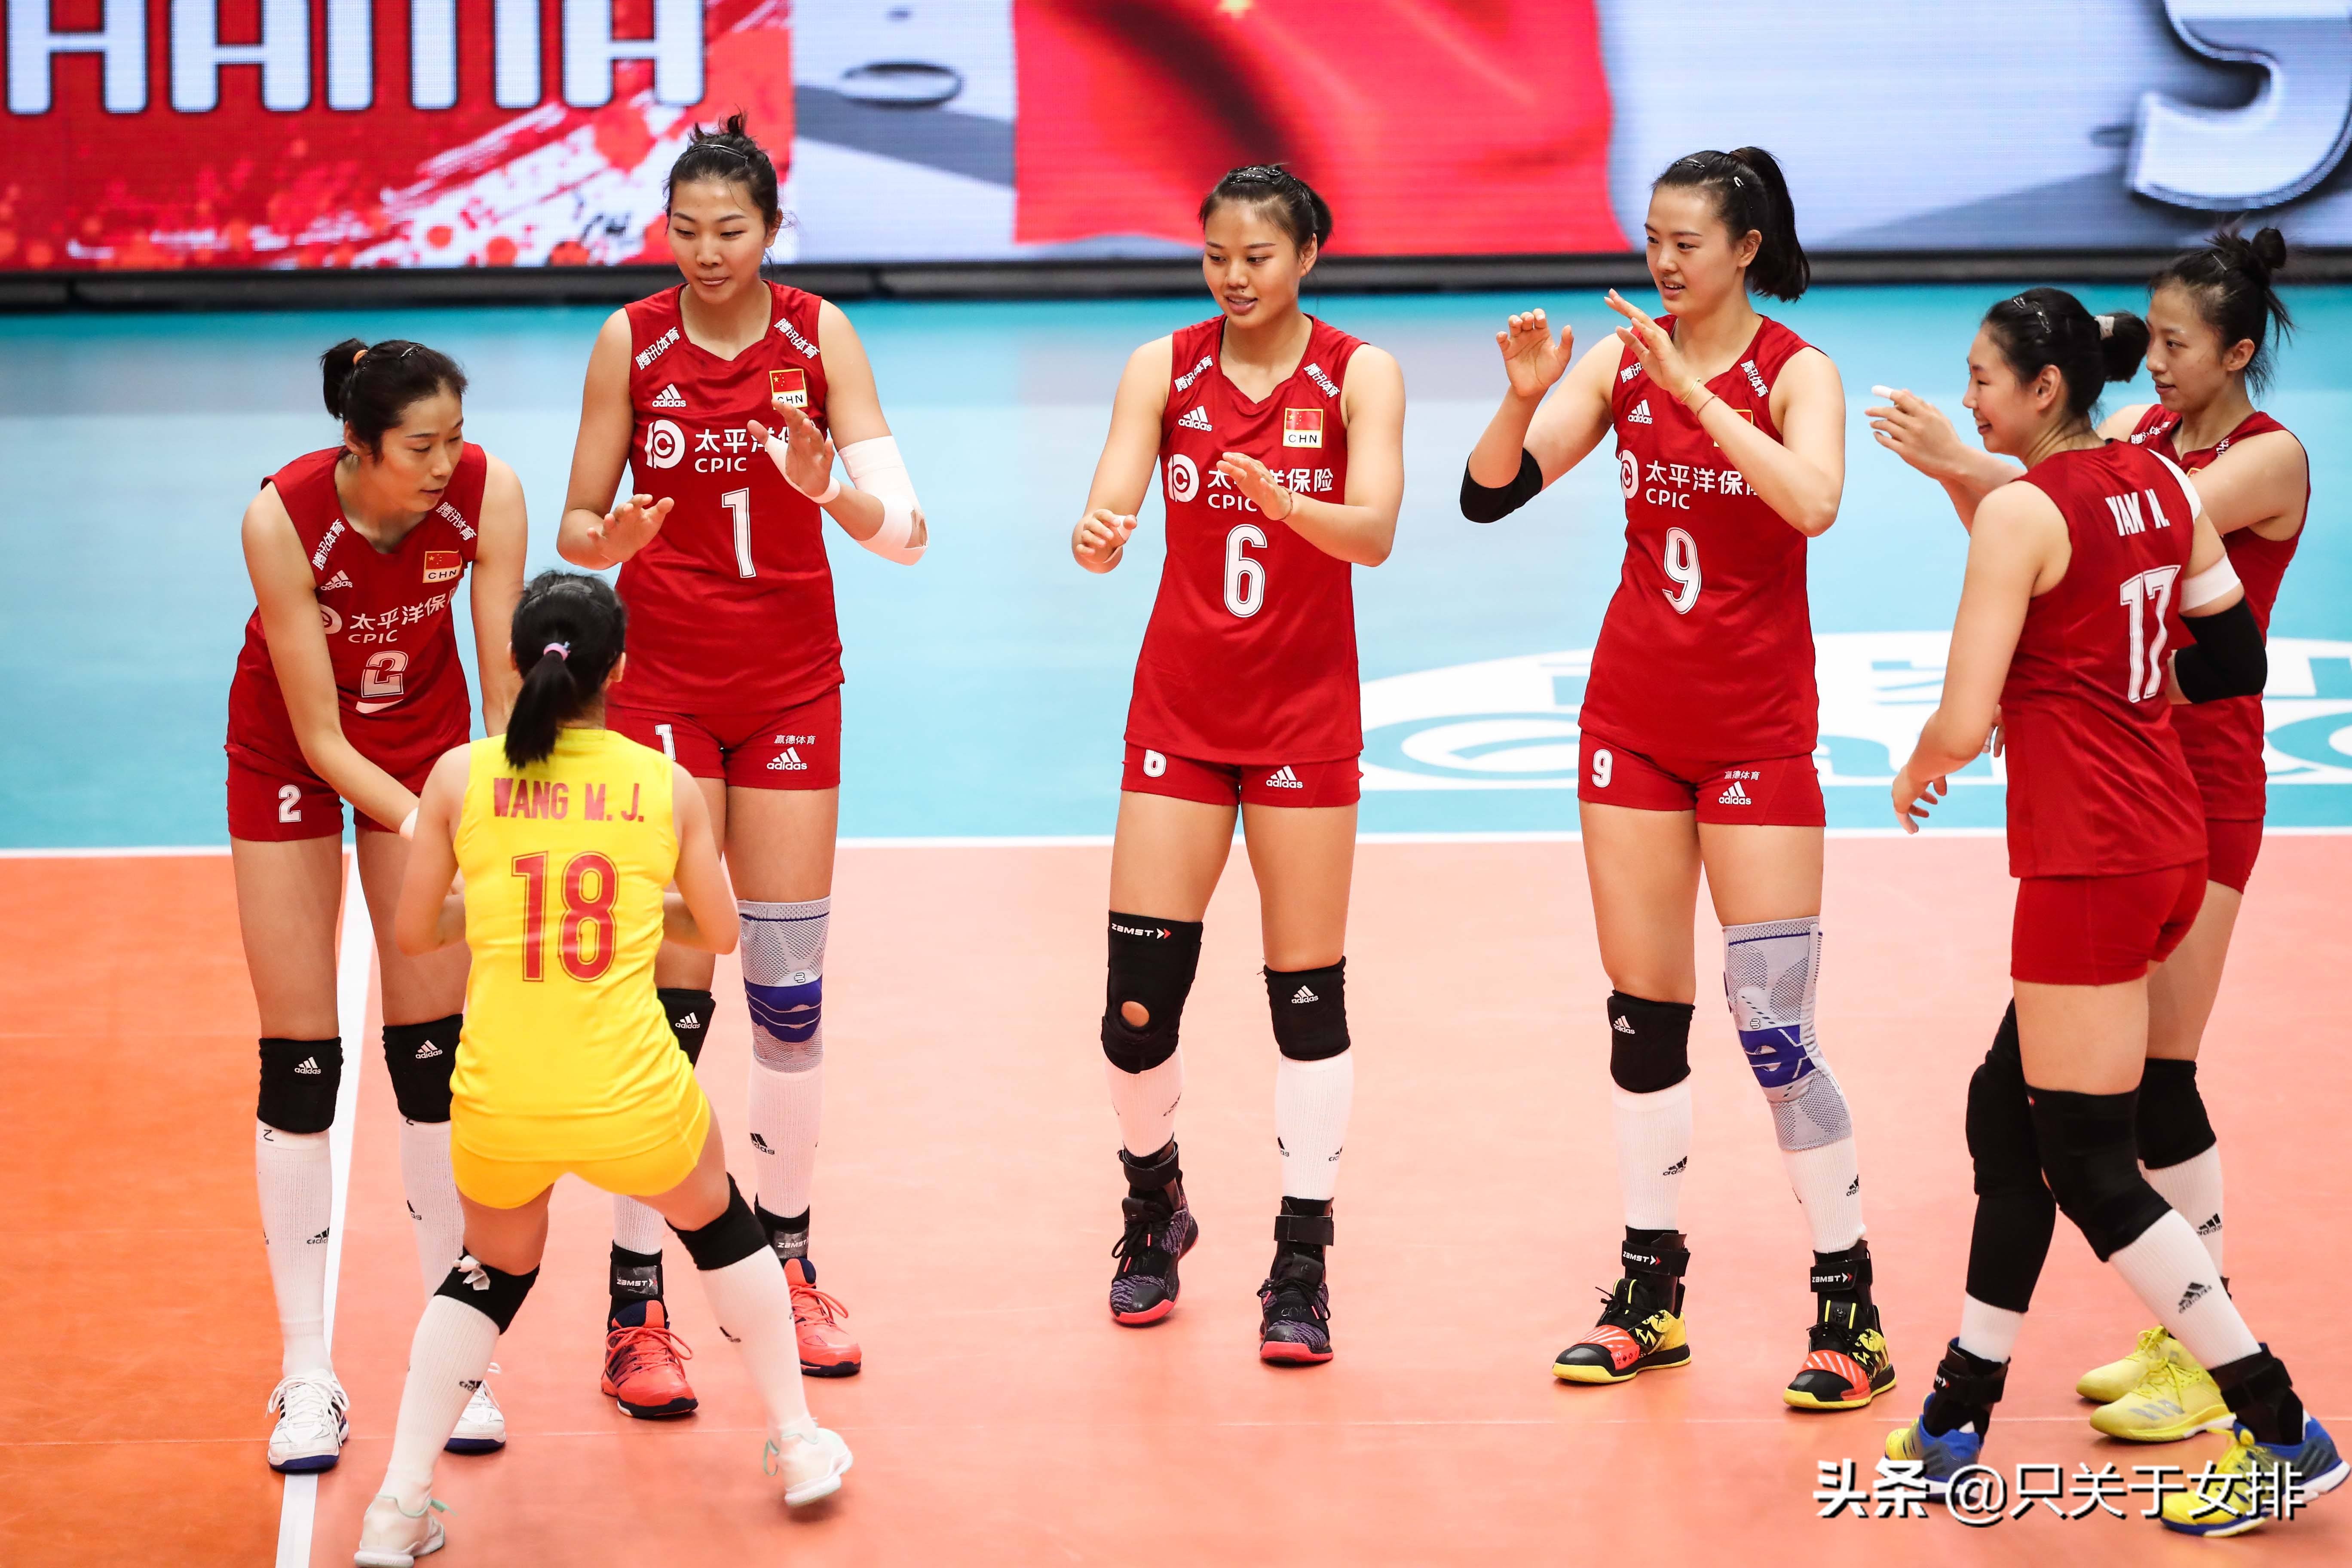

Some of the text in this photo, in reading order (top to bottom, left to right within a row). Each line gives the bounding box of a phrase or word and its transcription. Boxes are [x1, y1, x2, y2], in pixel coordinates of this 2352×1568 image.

[635, 327, 681, 370] 腾讯体育
[774, 318, 820, 359] 腾讯体育
[1174, 355, 1213, 392] 腾讯体育
[1303, 363, 1340, 398] 腾讯体育
[1620, 362, 1644, 383] 腾讯
[1740, 360, 1768, 398] 腾讯体育
[652, 398, 686, 407] adidas
[1178, 418, 1212, 432] adidas
[1628, 413, 1653, 425] adidas
[1289, 434, 1317, 444] CHN
[695, 457, 747, 472] CPIC
[1208, 494, 1257, 511] CPIC
[1646, 488, 1690, 510] CPIC
[436, 502, 477, 541] 腾讯体育
[2105, 492, 2146, 536] YAN
[312, 518, 345, 570] 腾讯体育
[722, 487, 756, 578] 1
[428, 569, 456, 580] CHN
[1224, 524, 1267, 618] 6
[1662, 527, 1702, 615] 9
[320, 580, 352, 591] adidas
[349, 585, 456, 631] 太平洋保
[348, 630, 397, 643] CPIC
[2120, 564, 2181, 703] 17
[361, 650, 408, 698] 2
[655, 724, 676, 761] 1
[774, 735, 816, 745] 赢德体育
[766, 761, 808, 770] adidas
[1592, 749, 1613, 788] 9
[1724, 770, 1761, 781] 赢德体育
[1266, 778, 1303, 788] adidas
[279, 785, 301, 823] 2
[493, 778, 644, 822] WANG M. J.
[1719, 795, 1752, 805] adidas
[511, 851, 618, 982] 18
[1291, 995, 1319, 1004] adidas
[1613, 1023, 1635, 1035] adidas
[416, 1049, 442, 1060] adidas
